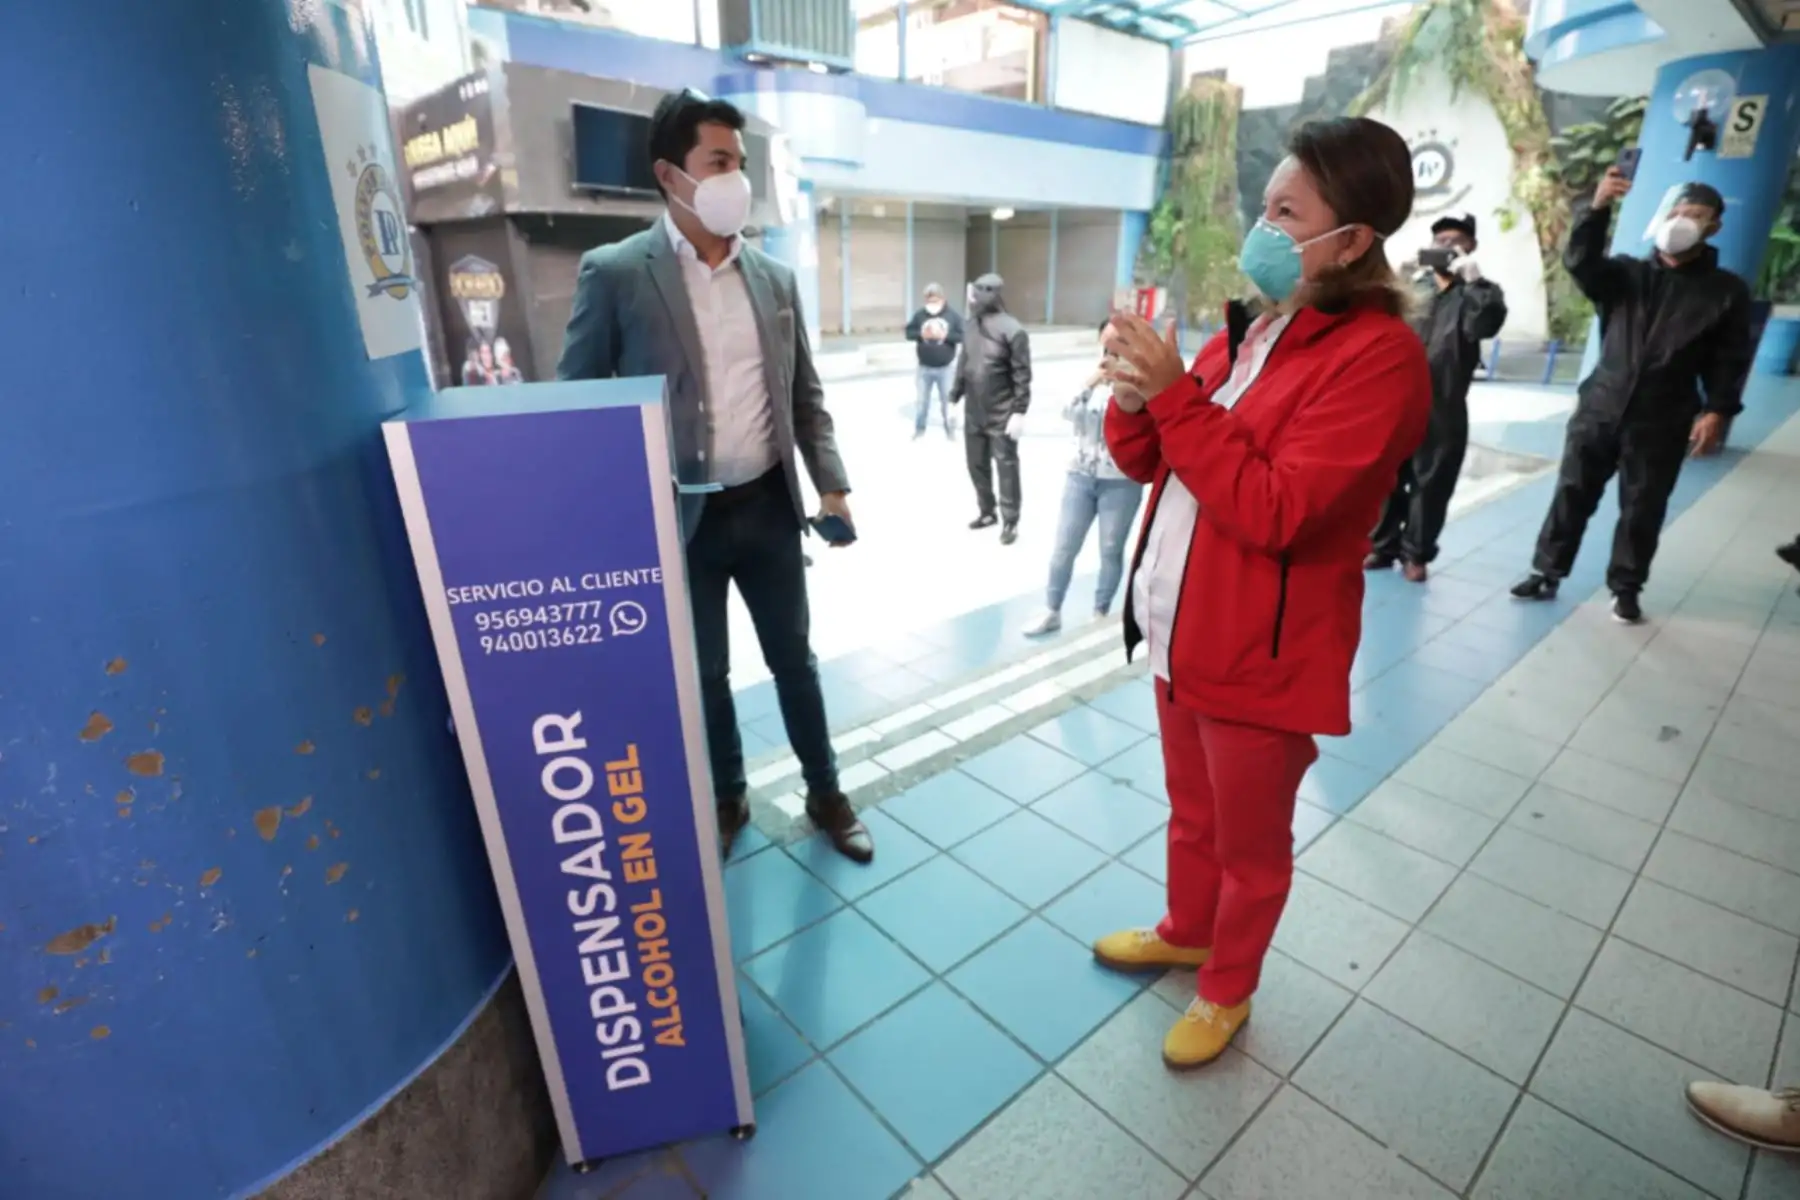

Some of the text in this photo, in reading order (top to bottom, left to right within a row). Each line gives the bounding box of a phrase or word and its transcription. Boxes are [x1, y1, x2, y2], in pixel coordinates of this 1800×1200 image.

[1733, 100, 1758, 132] S
[447, 567, 663, 605] SERVICIO AL CLIENTE
[474, 600, 602, 632] 956943777
[480, 623, 603, 655] 940013622
[532, 710, 651, 1091] DISPENSADOR
[605, 743, 685, 1047] ALCOHOL EN GEL
